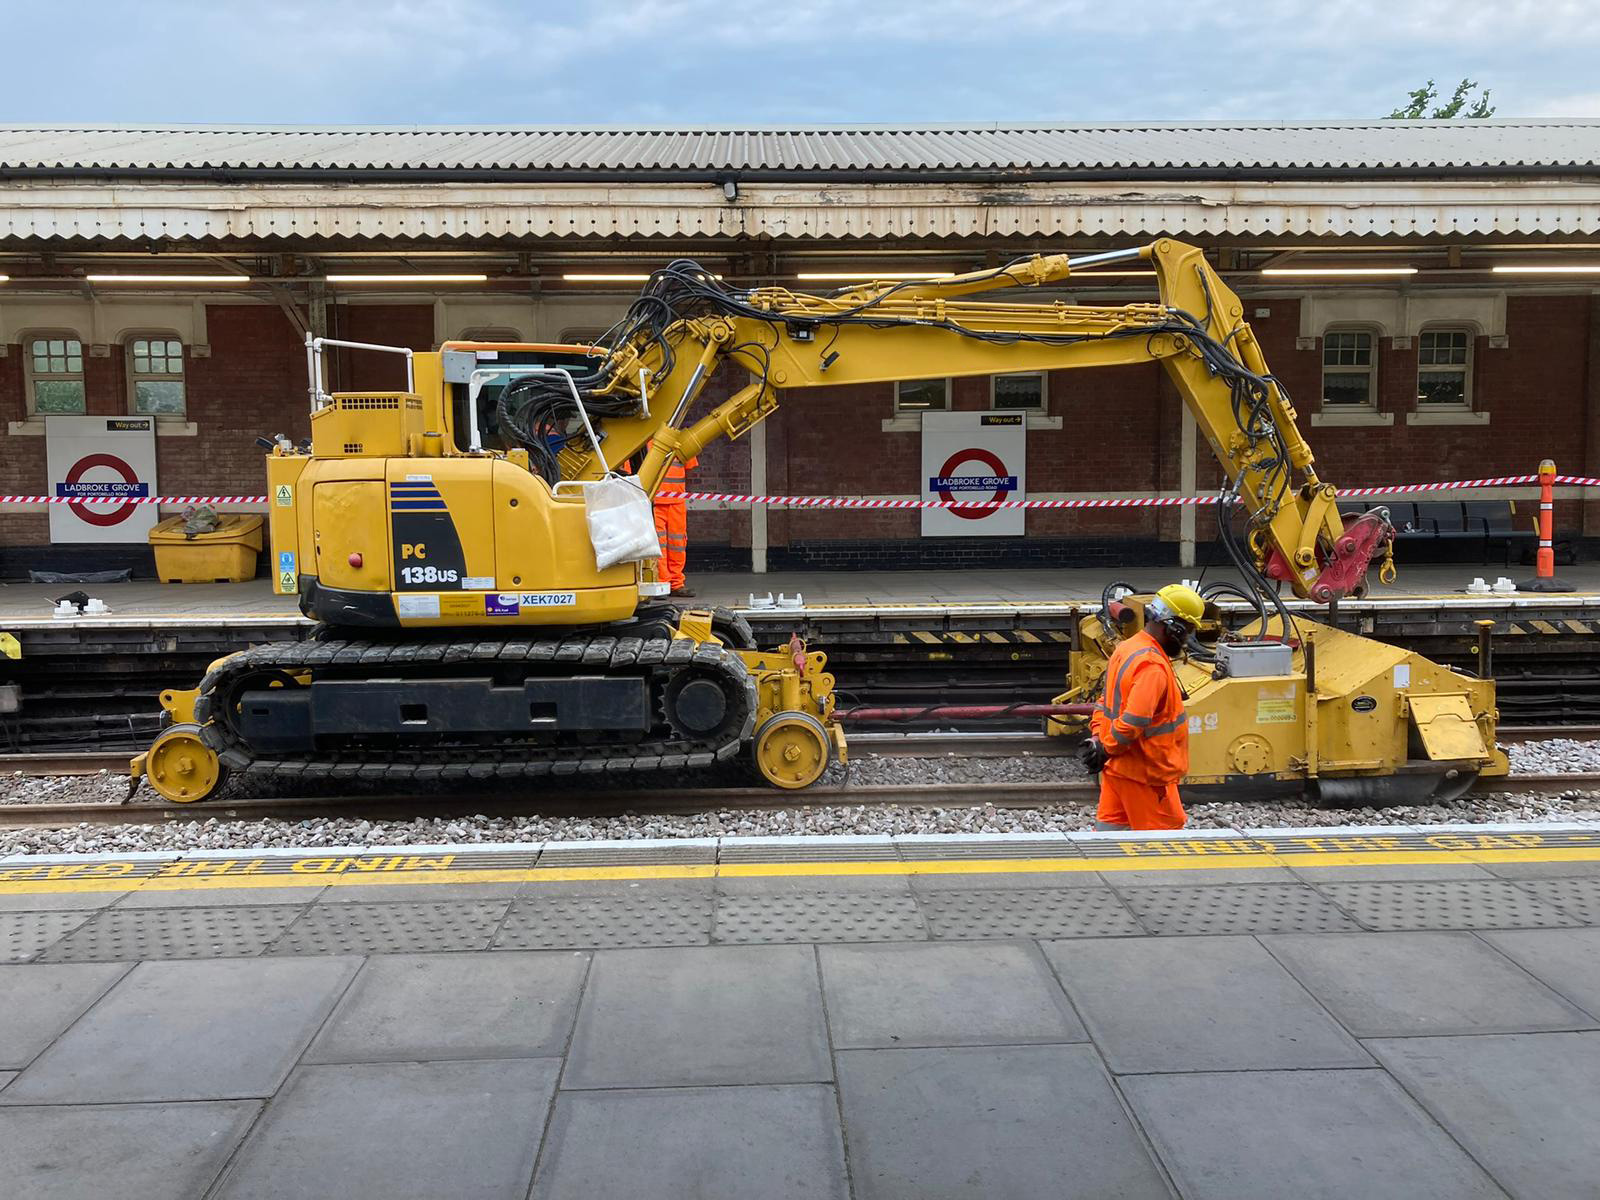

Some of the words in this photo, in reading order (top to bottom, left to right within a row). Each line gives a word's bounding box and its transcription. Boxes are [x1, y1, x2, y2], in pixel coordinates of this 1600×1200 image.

[989, 416, 1002, 424] Way
[115, 421, 129, 430] Way
[937, 477, 980, 486] LADBROKE
[982, 477, 1009, 485] GROVE
[64, 484, 109, 492] LADBROKE
[111, 484, 140, 492] GROVE
[401, 543, 426, 559] PC
[522, 595, 573, 605] XEK7027
[1118, 840, 1277, 856] MIND
[1289, 837, 1416, 851] THE
[1425, 834, 1545, 849] GAP
[290, 856, 455, 873] MIND
